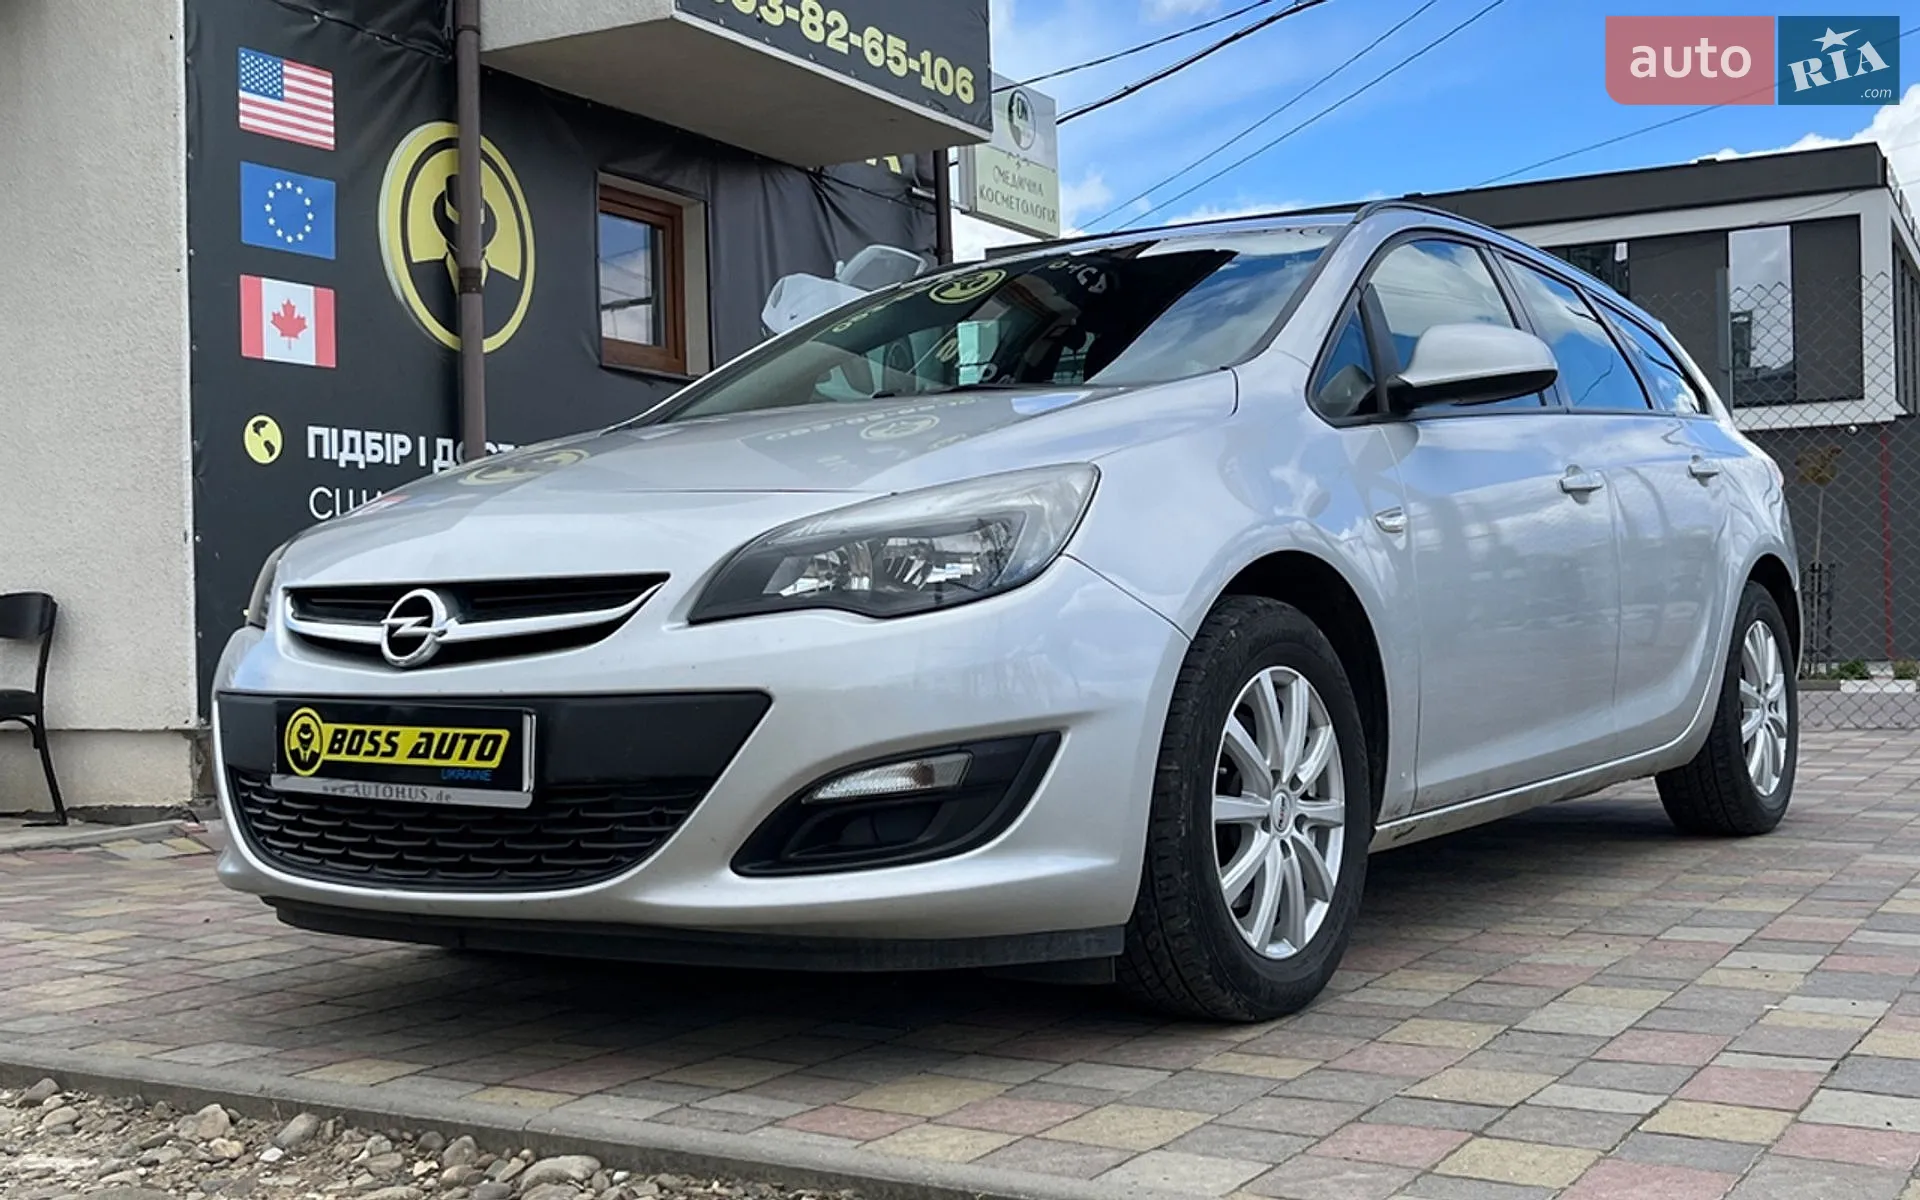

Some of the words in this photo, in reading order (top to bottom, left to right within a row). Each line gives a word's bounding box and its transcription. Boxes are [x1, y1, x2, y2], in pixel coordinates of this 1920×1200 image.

[714, 0, 975, 104] 3-82-65-106
[307, 425, 412, 469] ПІДБІР
[418, 436, 427, 467] І
[327, 728, 401, 758] BOSS
[407, 732, 503, 762] AUTO
[441, 768, 492, 781] UKRAINE
